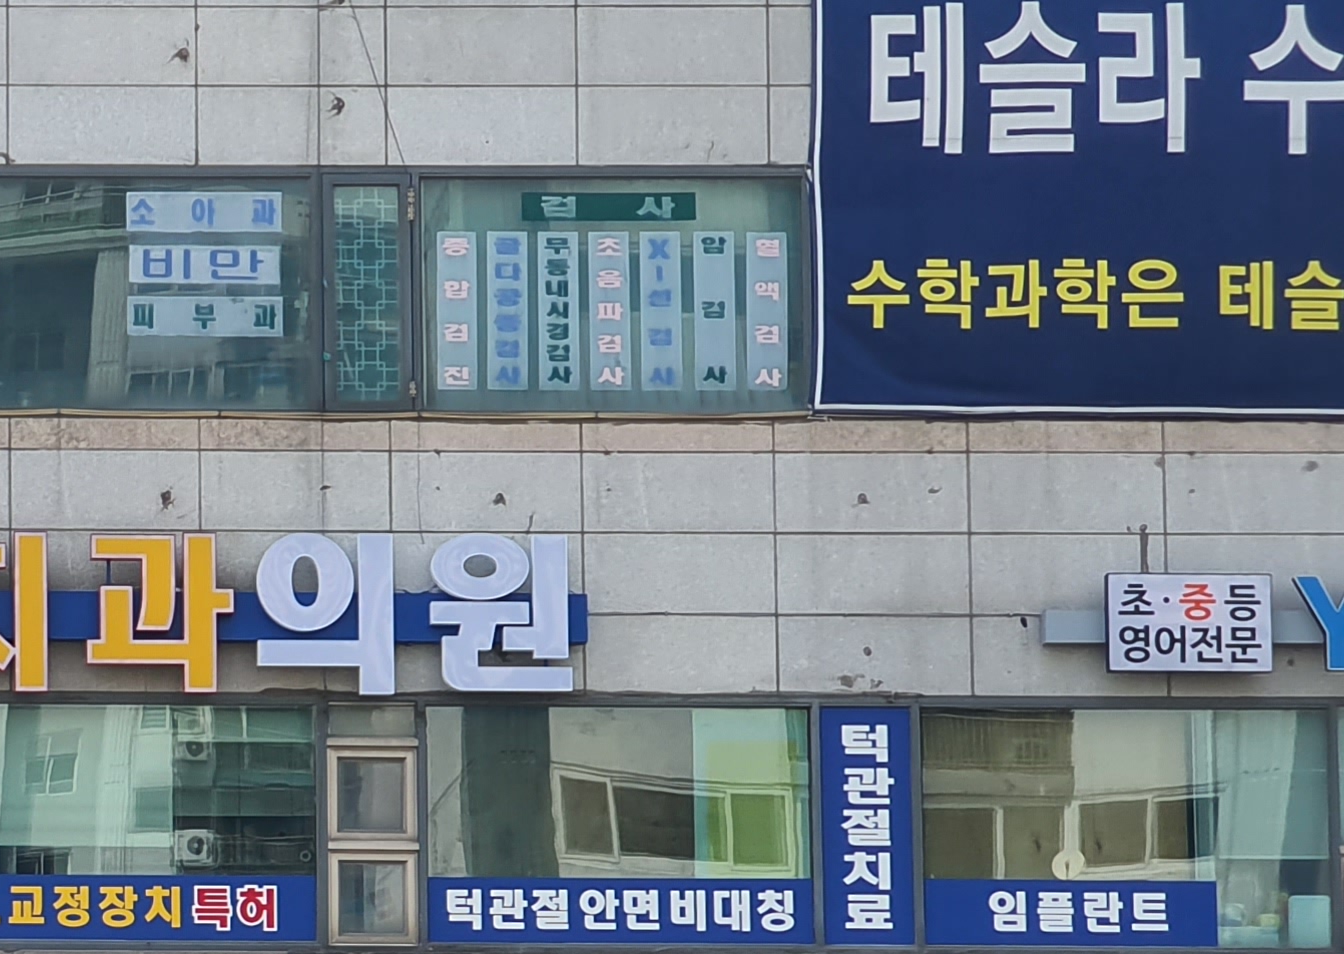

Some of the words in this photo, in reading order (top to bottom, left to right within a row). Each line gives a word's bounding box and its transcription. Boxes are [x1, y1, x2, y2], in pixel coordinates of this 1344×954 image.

[869, 1, 1201, 154] 테슬라
[1243, 4, 1344, 154] 수
[129, 197, 277, 227] 소아과
[540, 194, 676, 219] 검사
[142, 249, 265, 280] 비만
[847, 259, 1184, 330] 수학과학은
[1219, 260, 1344, 331] 테슬
[132, 303, 278, 331] 피부과
[1118, 625, 1262, 664] 영어전문
[839, 722, 895, 930] 턱관절치료
[988, 888, 1170, 934] 임플란트
